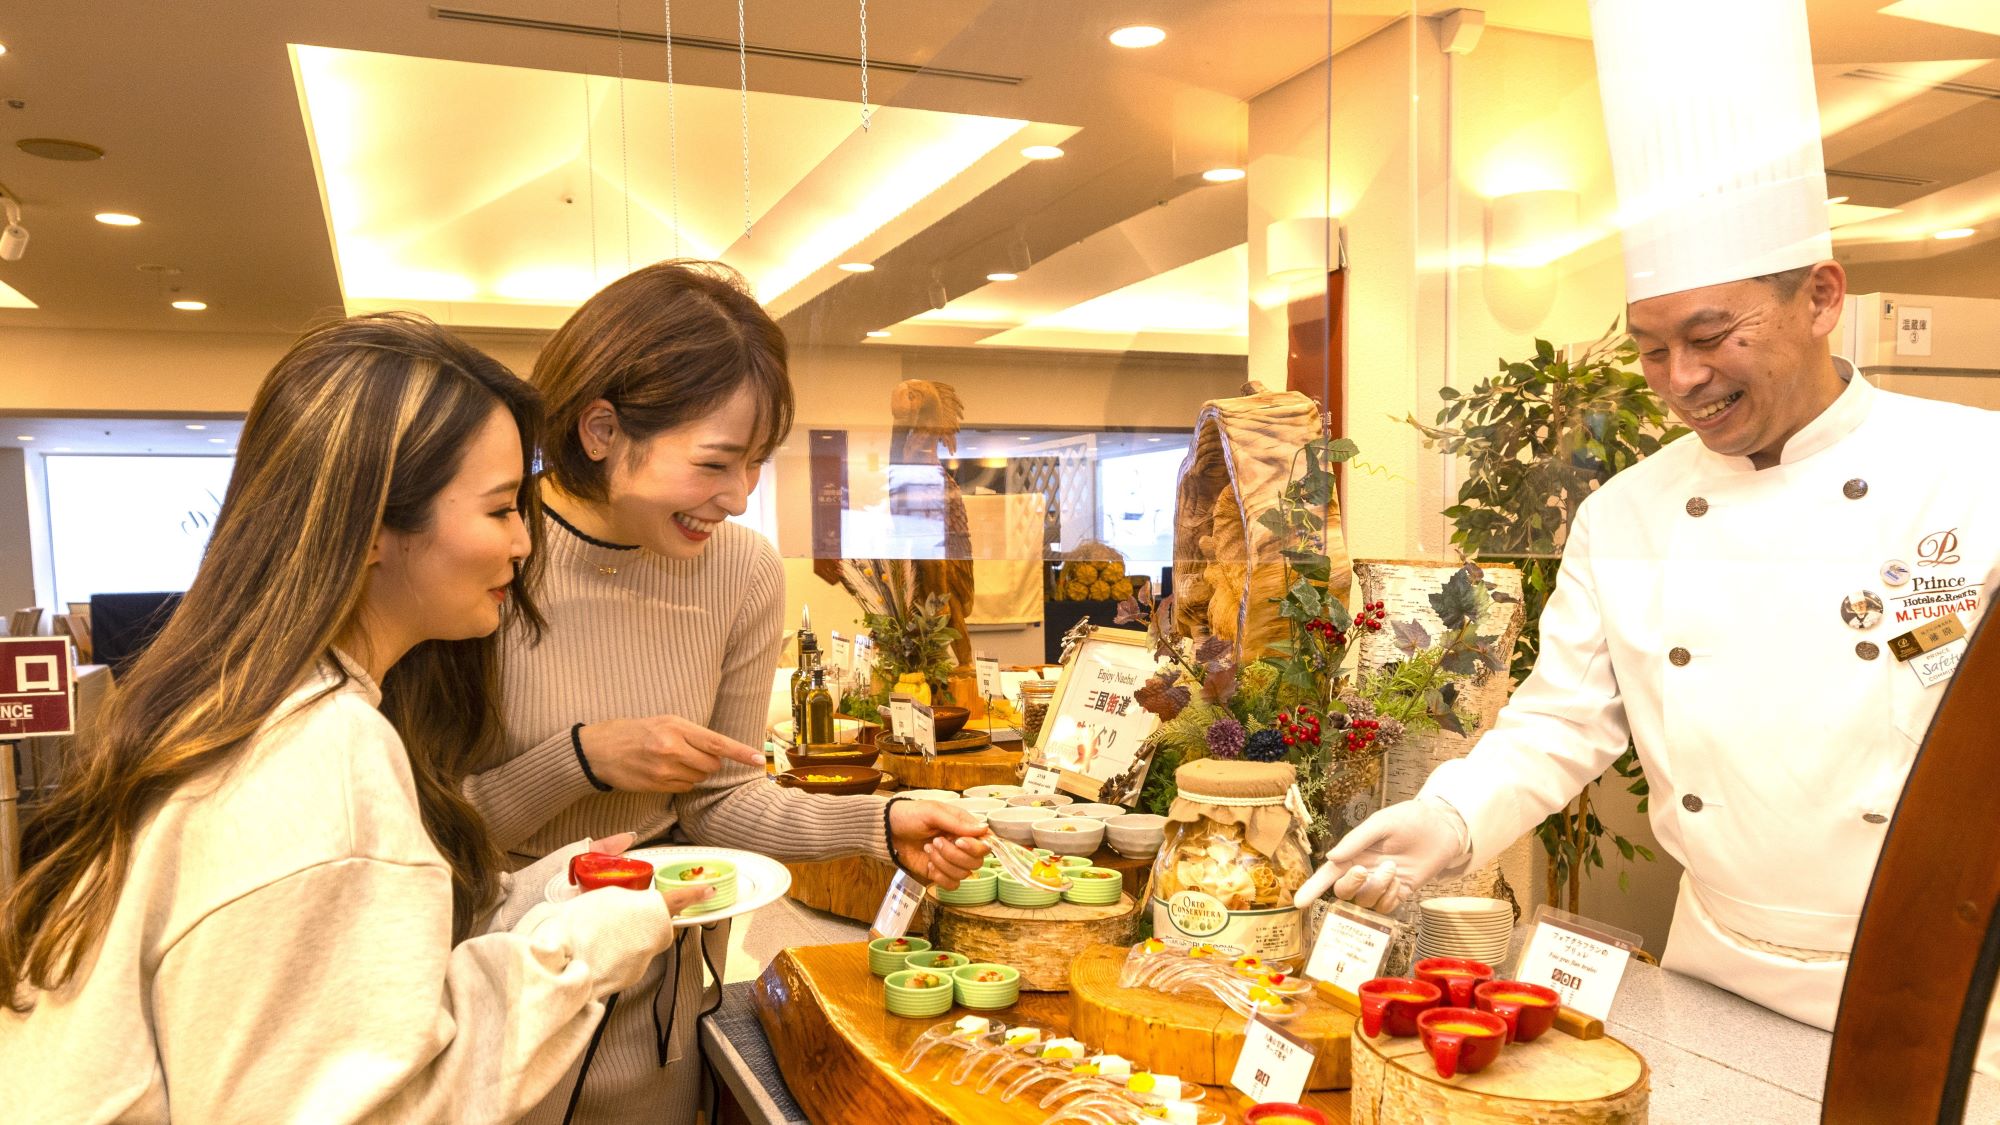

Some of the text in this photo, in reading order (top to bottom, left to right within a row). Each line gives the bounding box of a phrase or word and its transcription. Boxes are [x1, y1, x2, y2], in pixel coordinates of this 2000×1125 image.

[1911, 576, 1966, 592] Prince
[1895, 598, 1981, 623] M.FUJIWAR
[1097, 668, 1116, 684] Enjoy
[1084, 691, 1132, 717] 三国街道
